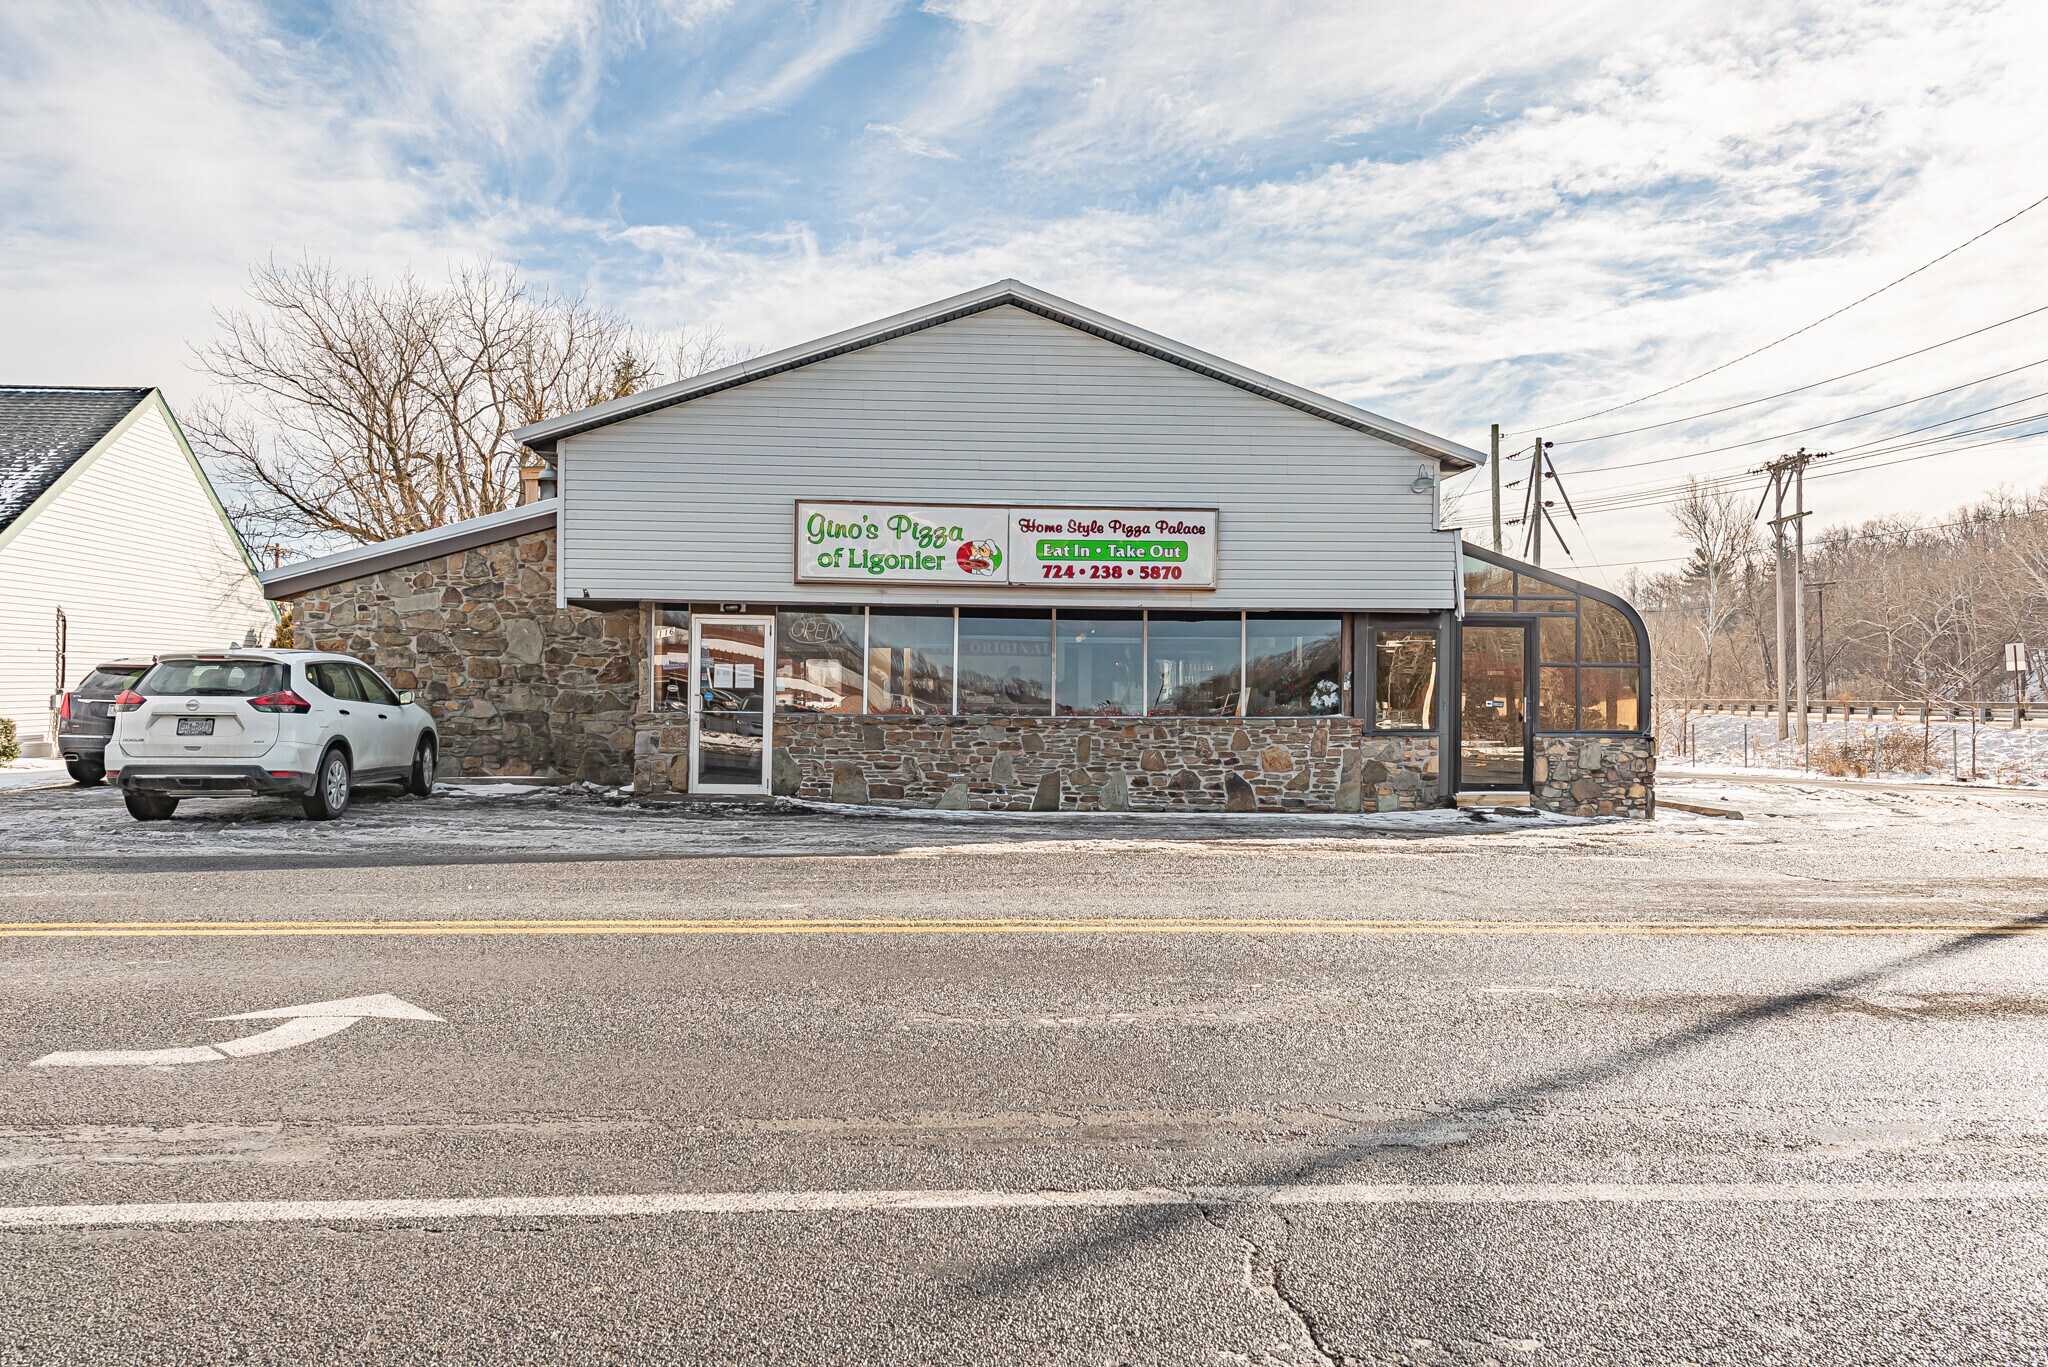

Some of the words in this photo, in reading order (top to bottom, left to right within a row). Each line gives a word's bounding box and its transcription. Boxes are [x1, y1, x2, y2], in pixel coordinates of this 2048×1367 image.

[806, 512, 879, 545] Gino's
[886, 514, 965, 549] Pizza
[1018, 518, 1063, 534] Home
[1066, 519, 1104, 537] Style
[1108, 519, 1151, 538] Pizza
[1155, 520, 1206, 535] Palace
[1042, 543, 1071, 558] Eat
[1073, 544, 1091, 558] In
[1107, 544, 1146, 558] Take
[1149, 544, 1181, 558] Out
[817, 547, 845, 568] of
[848, 548, 946, 575] Ligonier
[1041, 565, 1075, 579] 724
[1089, 565, 1123, 580] 238
[1139, 565, 1182, 580] 5870
[658, 627, 675, 638] 116
[791, 620, 840, 641] OPEN
[969, 641, 1051, 655] ORIGINAL
